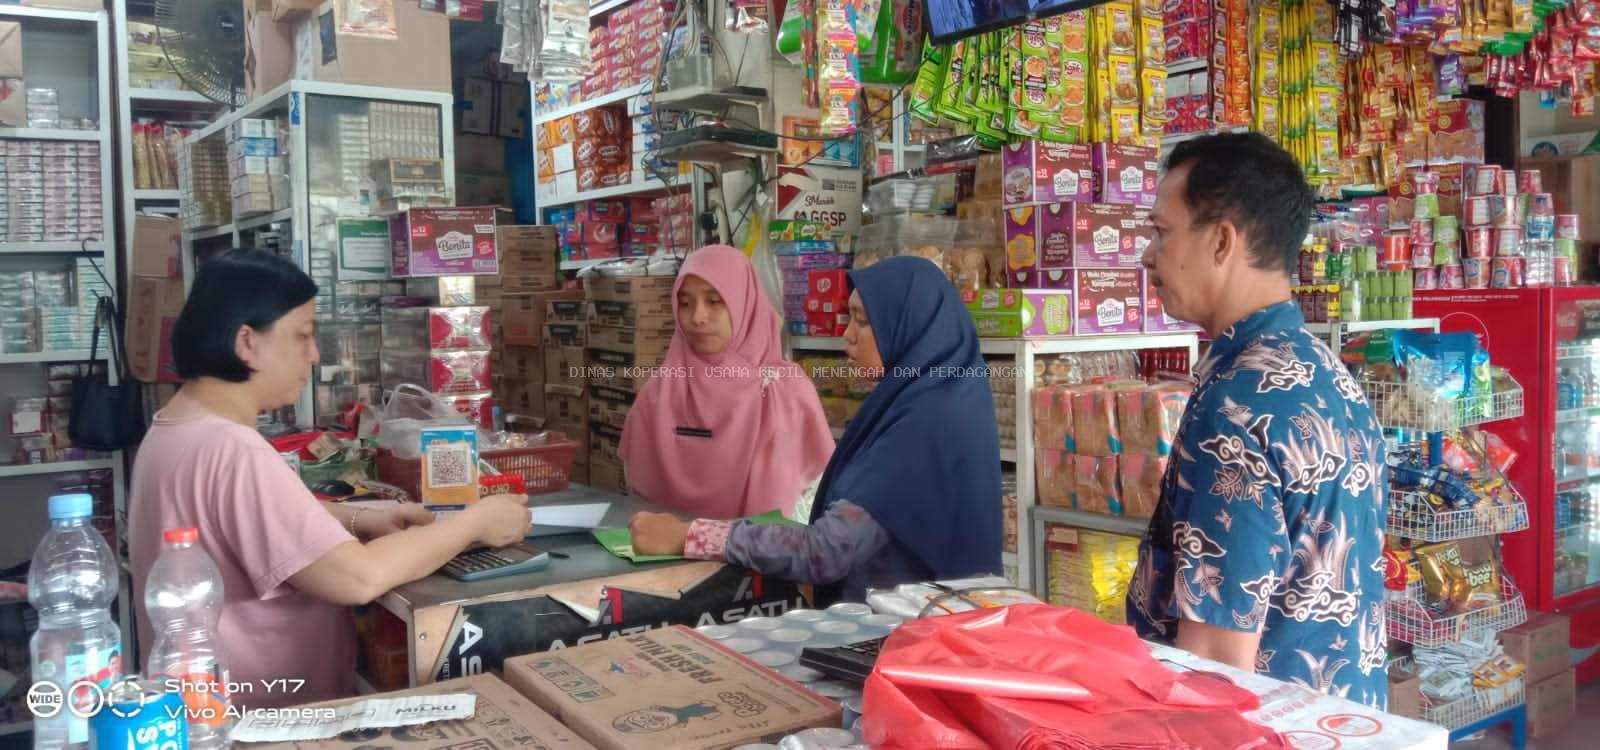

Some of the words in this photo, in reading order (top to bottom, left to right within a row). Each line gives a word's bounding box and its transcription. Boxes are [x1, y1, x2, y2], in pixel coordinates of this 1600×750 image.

[811, 210, 847, 226] GGSP
[438, 239, 471, 252] Benita
[1098, 305, 1122, 319] Benita
